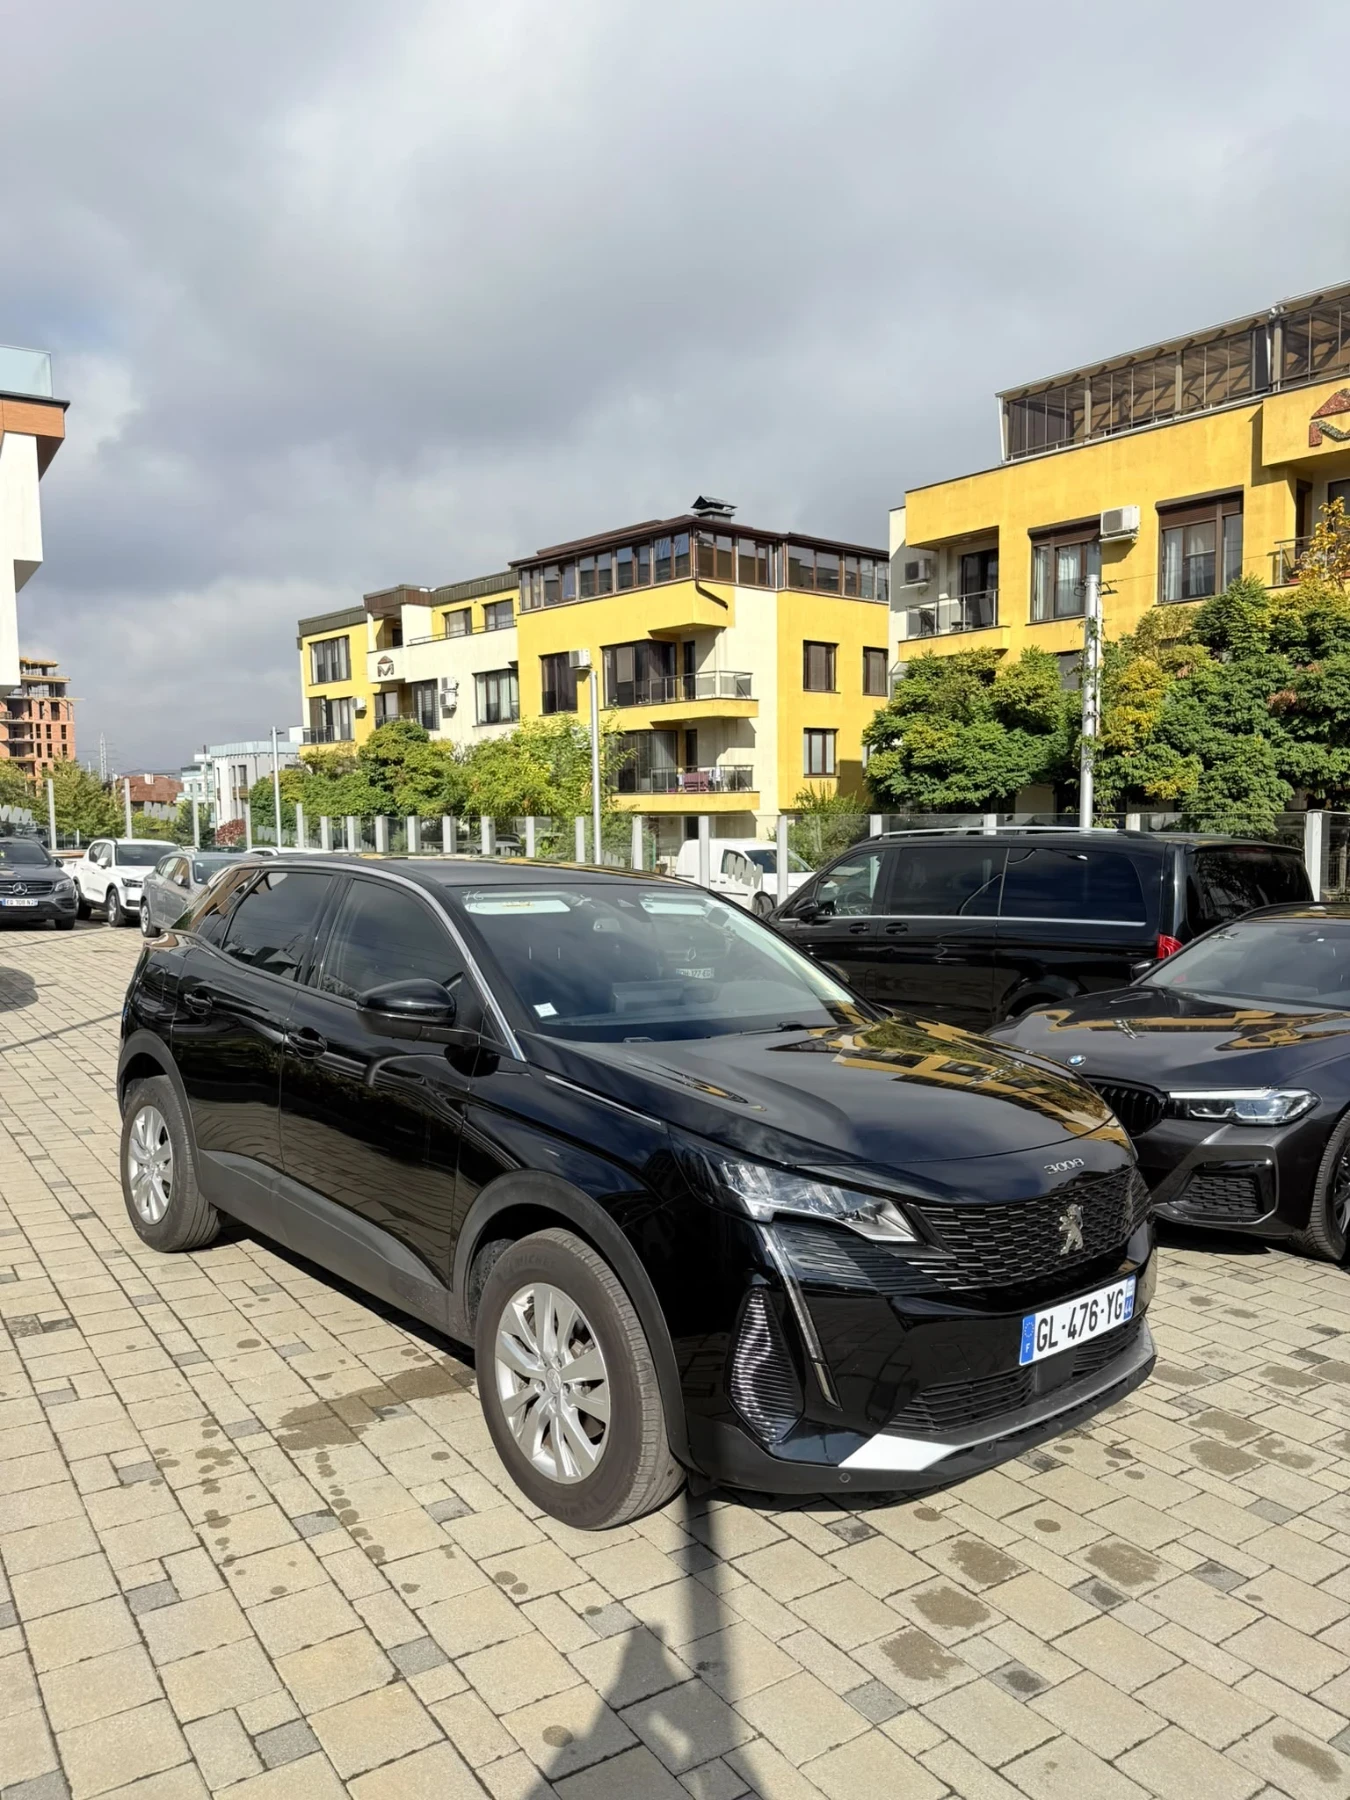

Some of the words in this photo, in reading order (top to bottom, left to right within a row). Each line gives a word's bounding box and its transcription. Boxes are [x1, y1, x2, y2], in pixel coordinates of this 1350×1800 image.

[1043, 1157, 1085, 1175] 3008
[1036, 1288, 1124, 1352] GL-476-YG
[1025, 1343, 1031, 1353] F
